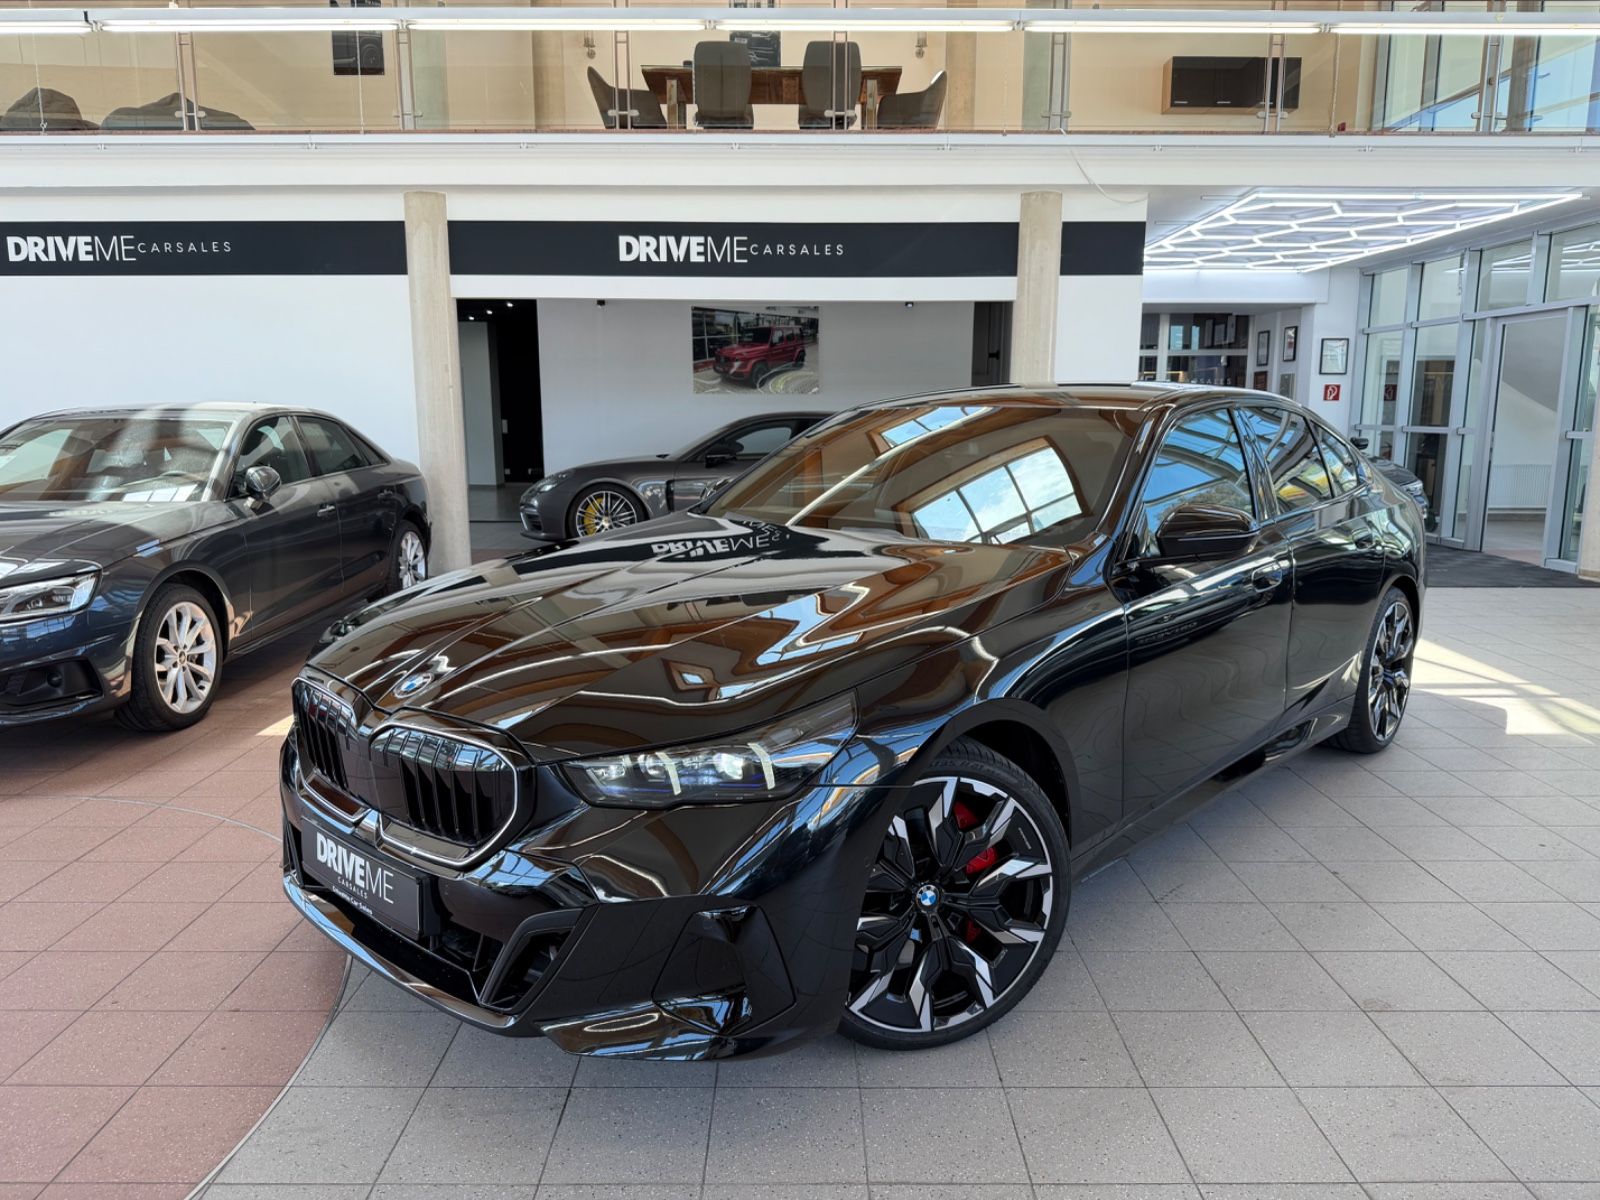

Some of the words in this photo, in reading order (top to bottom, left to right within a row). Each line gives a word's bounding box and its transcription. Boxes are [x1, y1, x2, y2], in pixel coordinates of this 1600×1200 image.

[6, 235, 137, 262] DRIVEME
[137, 241, 232, 254] CARSALES
[618, 235, 748, 263] DRIVEME
[750, 243, 844, 256] CARSALES
[316, 831, 395, 904] DRIVEME
